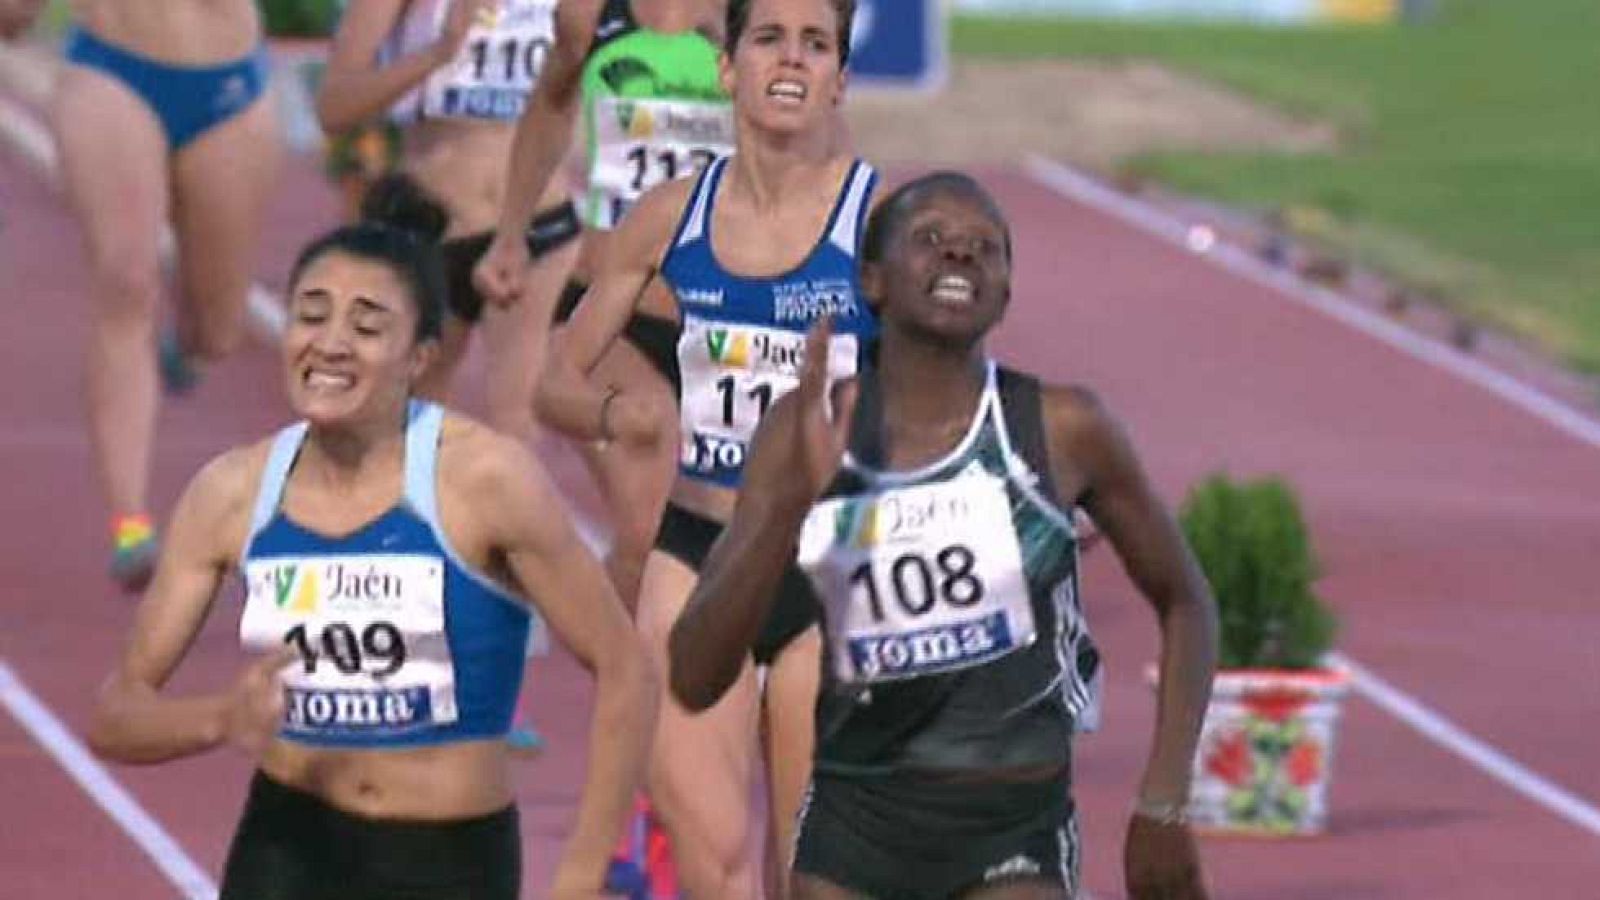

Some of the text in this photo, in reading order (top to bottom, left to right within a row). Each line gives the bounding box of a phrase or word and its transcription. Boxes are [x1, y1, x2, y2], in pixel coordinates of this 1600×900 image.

[469, 39, 552, 82] 110
[753, 334, 807, 368] Jaé
[716, 374, 773, 427] 11
[326, 562, 403, 601] Jaén
[849, 544, 985, 623] 108
[283, 620, 406, 682] 109
